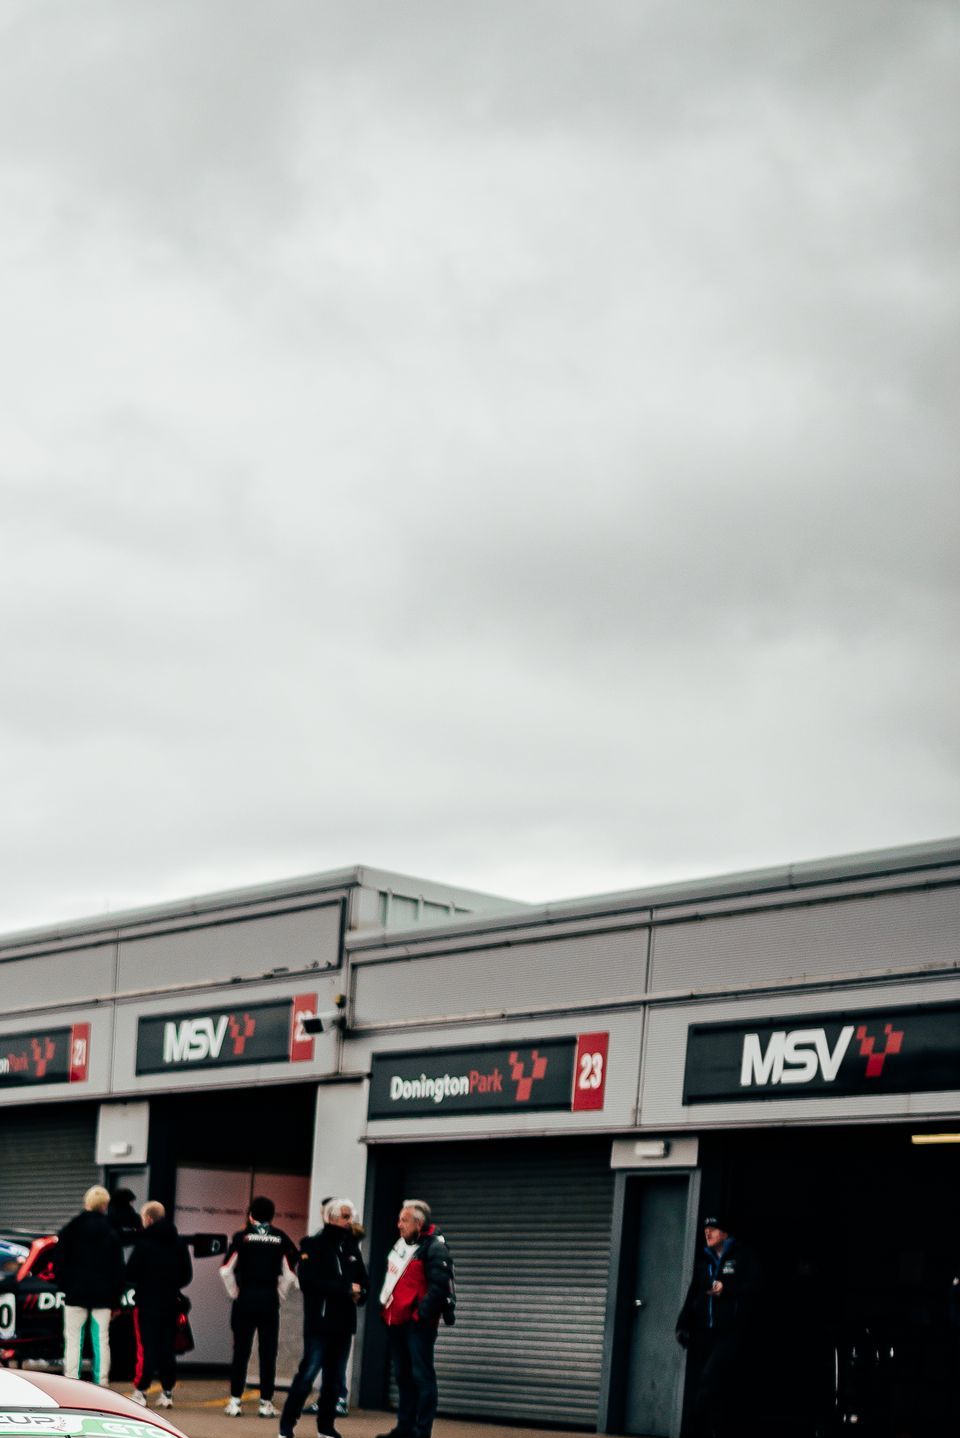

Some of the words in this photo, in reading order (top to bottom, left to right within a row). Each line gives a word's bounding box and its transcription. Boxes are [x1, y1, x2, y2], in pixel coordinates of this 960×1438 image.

[163, 1015, 229, 1063] MSV
[740, 1025, 855, 1087] MSV
[579, 1052, 603, 1089] 23
